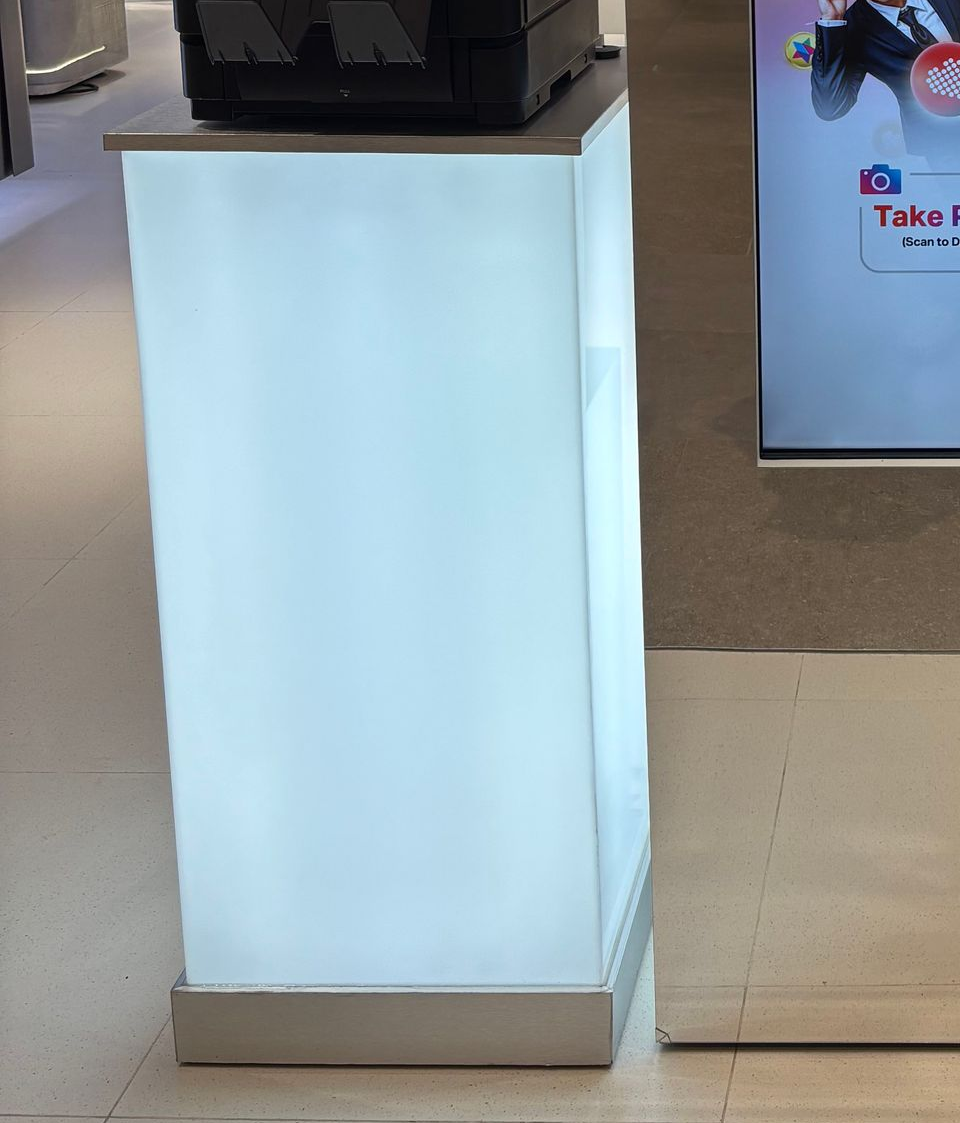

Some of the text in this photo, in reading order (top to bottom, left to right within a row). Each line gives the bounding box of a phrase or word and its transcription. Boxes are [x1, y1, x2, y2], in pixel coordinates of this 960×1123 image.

[874, 205, 943, 228] Take
[902, 235, 934, 249] (Scan
[936, 236, 948, 247] to
